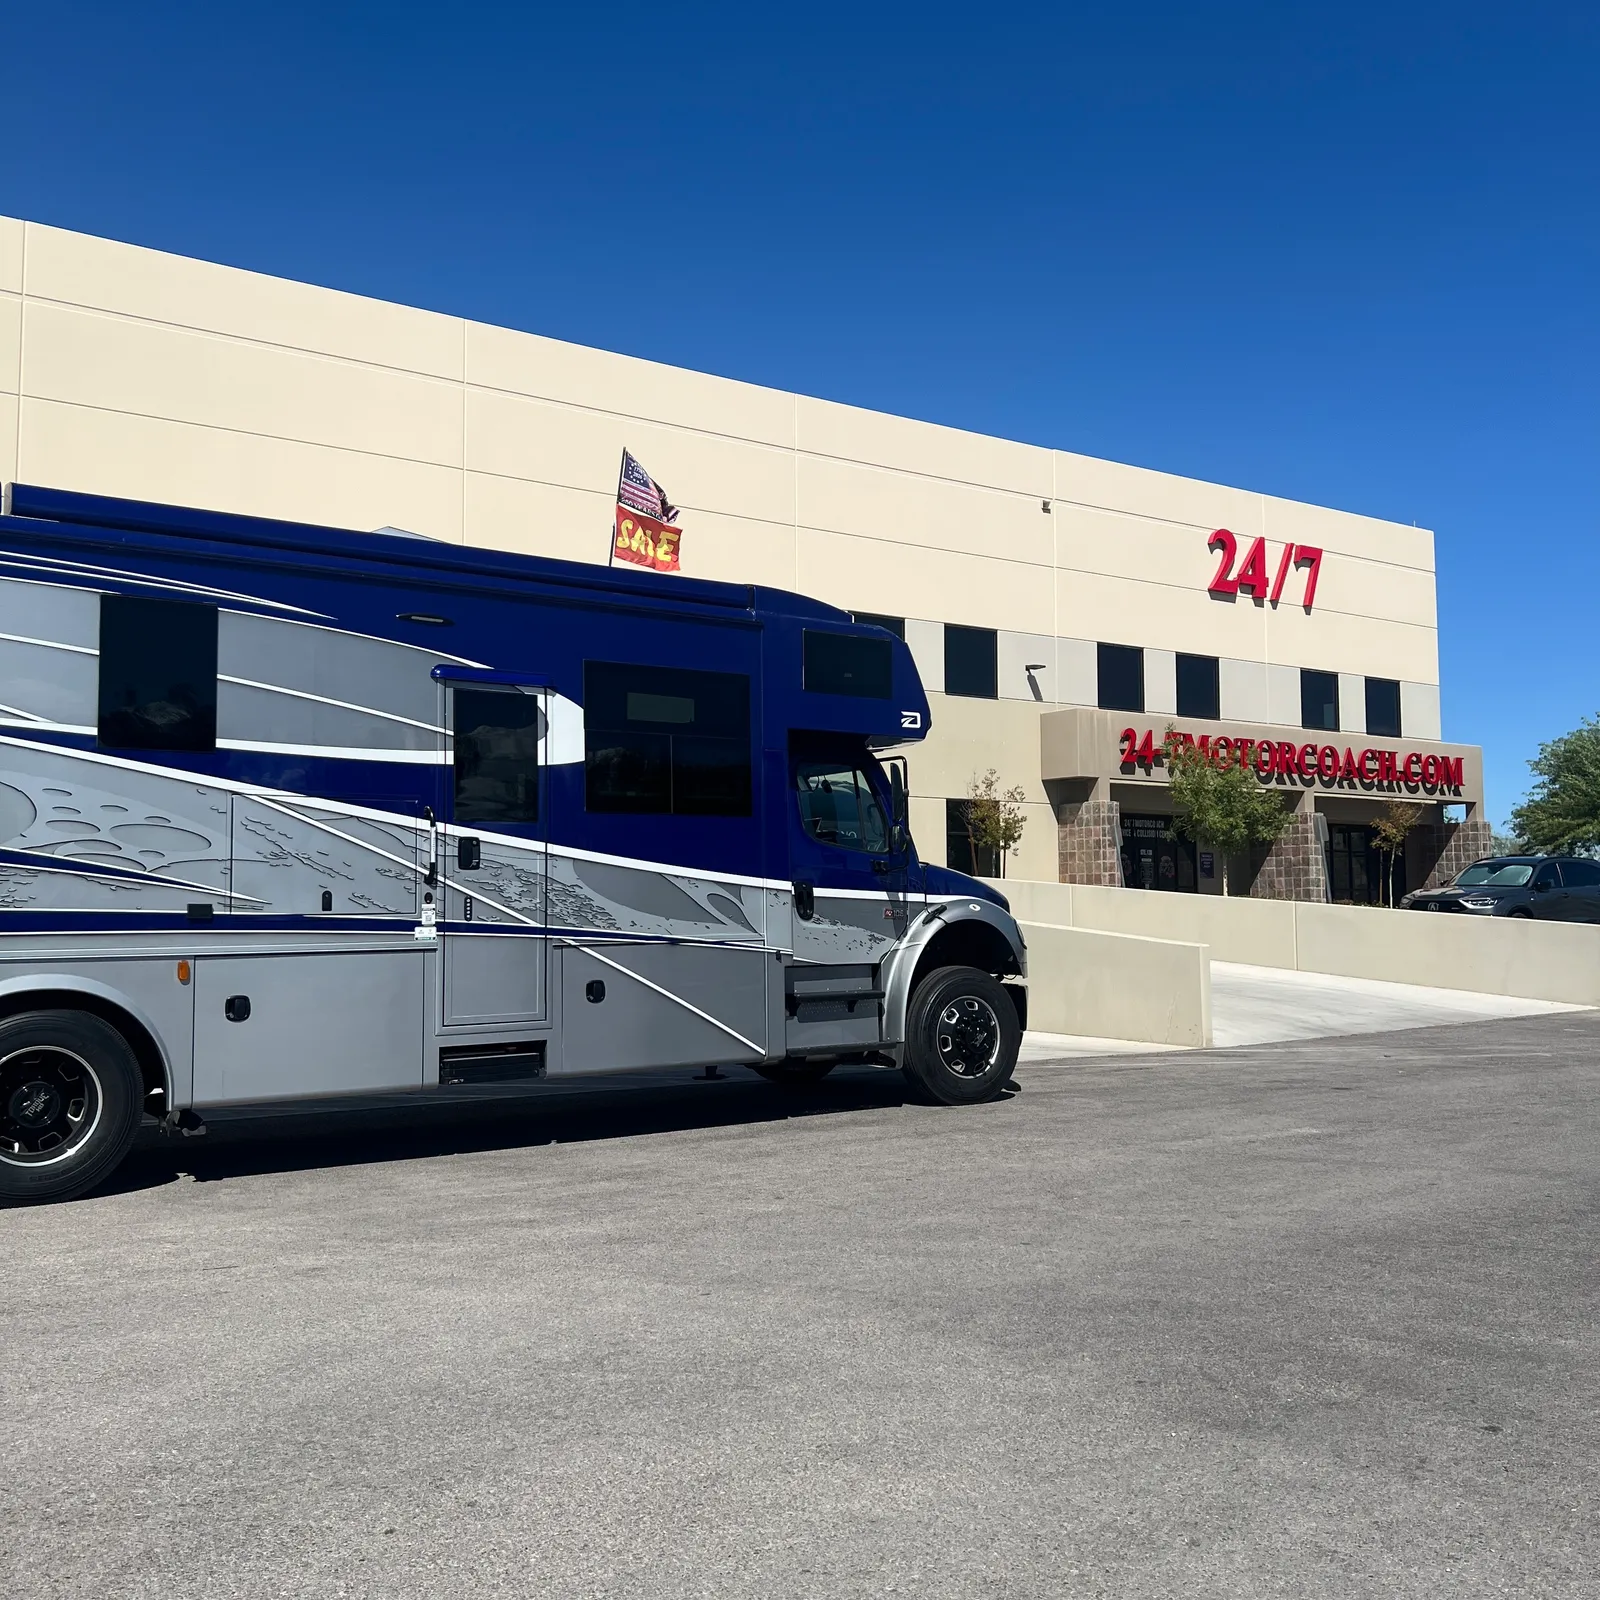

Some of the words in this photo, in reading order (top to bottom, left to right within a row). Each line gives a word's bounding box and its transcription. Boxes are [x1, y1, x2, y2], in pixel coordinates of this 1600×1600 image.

[616, 519, 680, 562] SALE
[1208, 528, 1323, 607] 24/7
[24, 1092, 50, 1117] TORQUE
